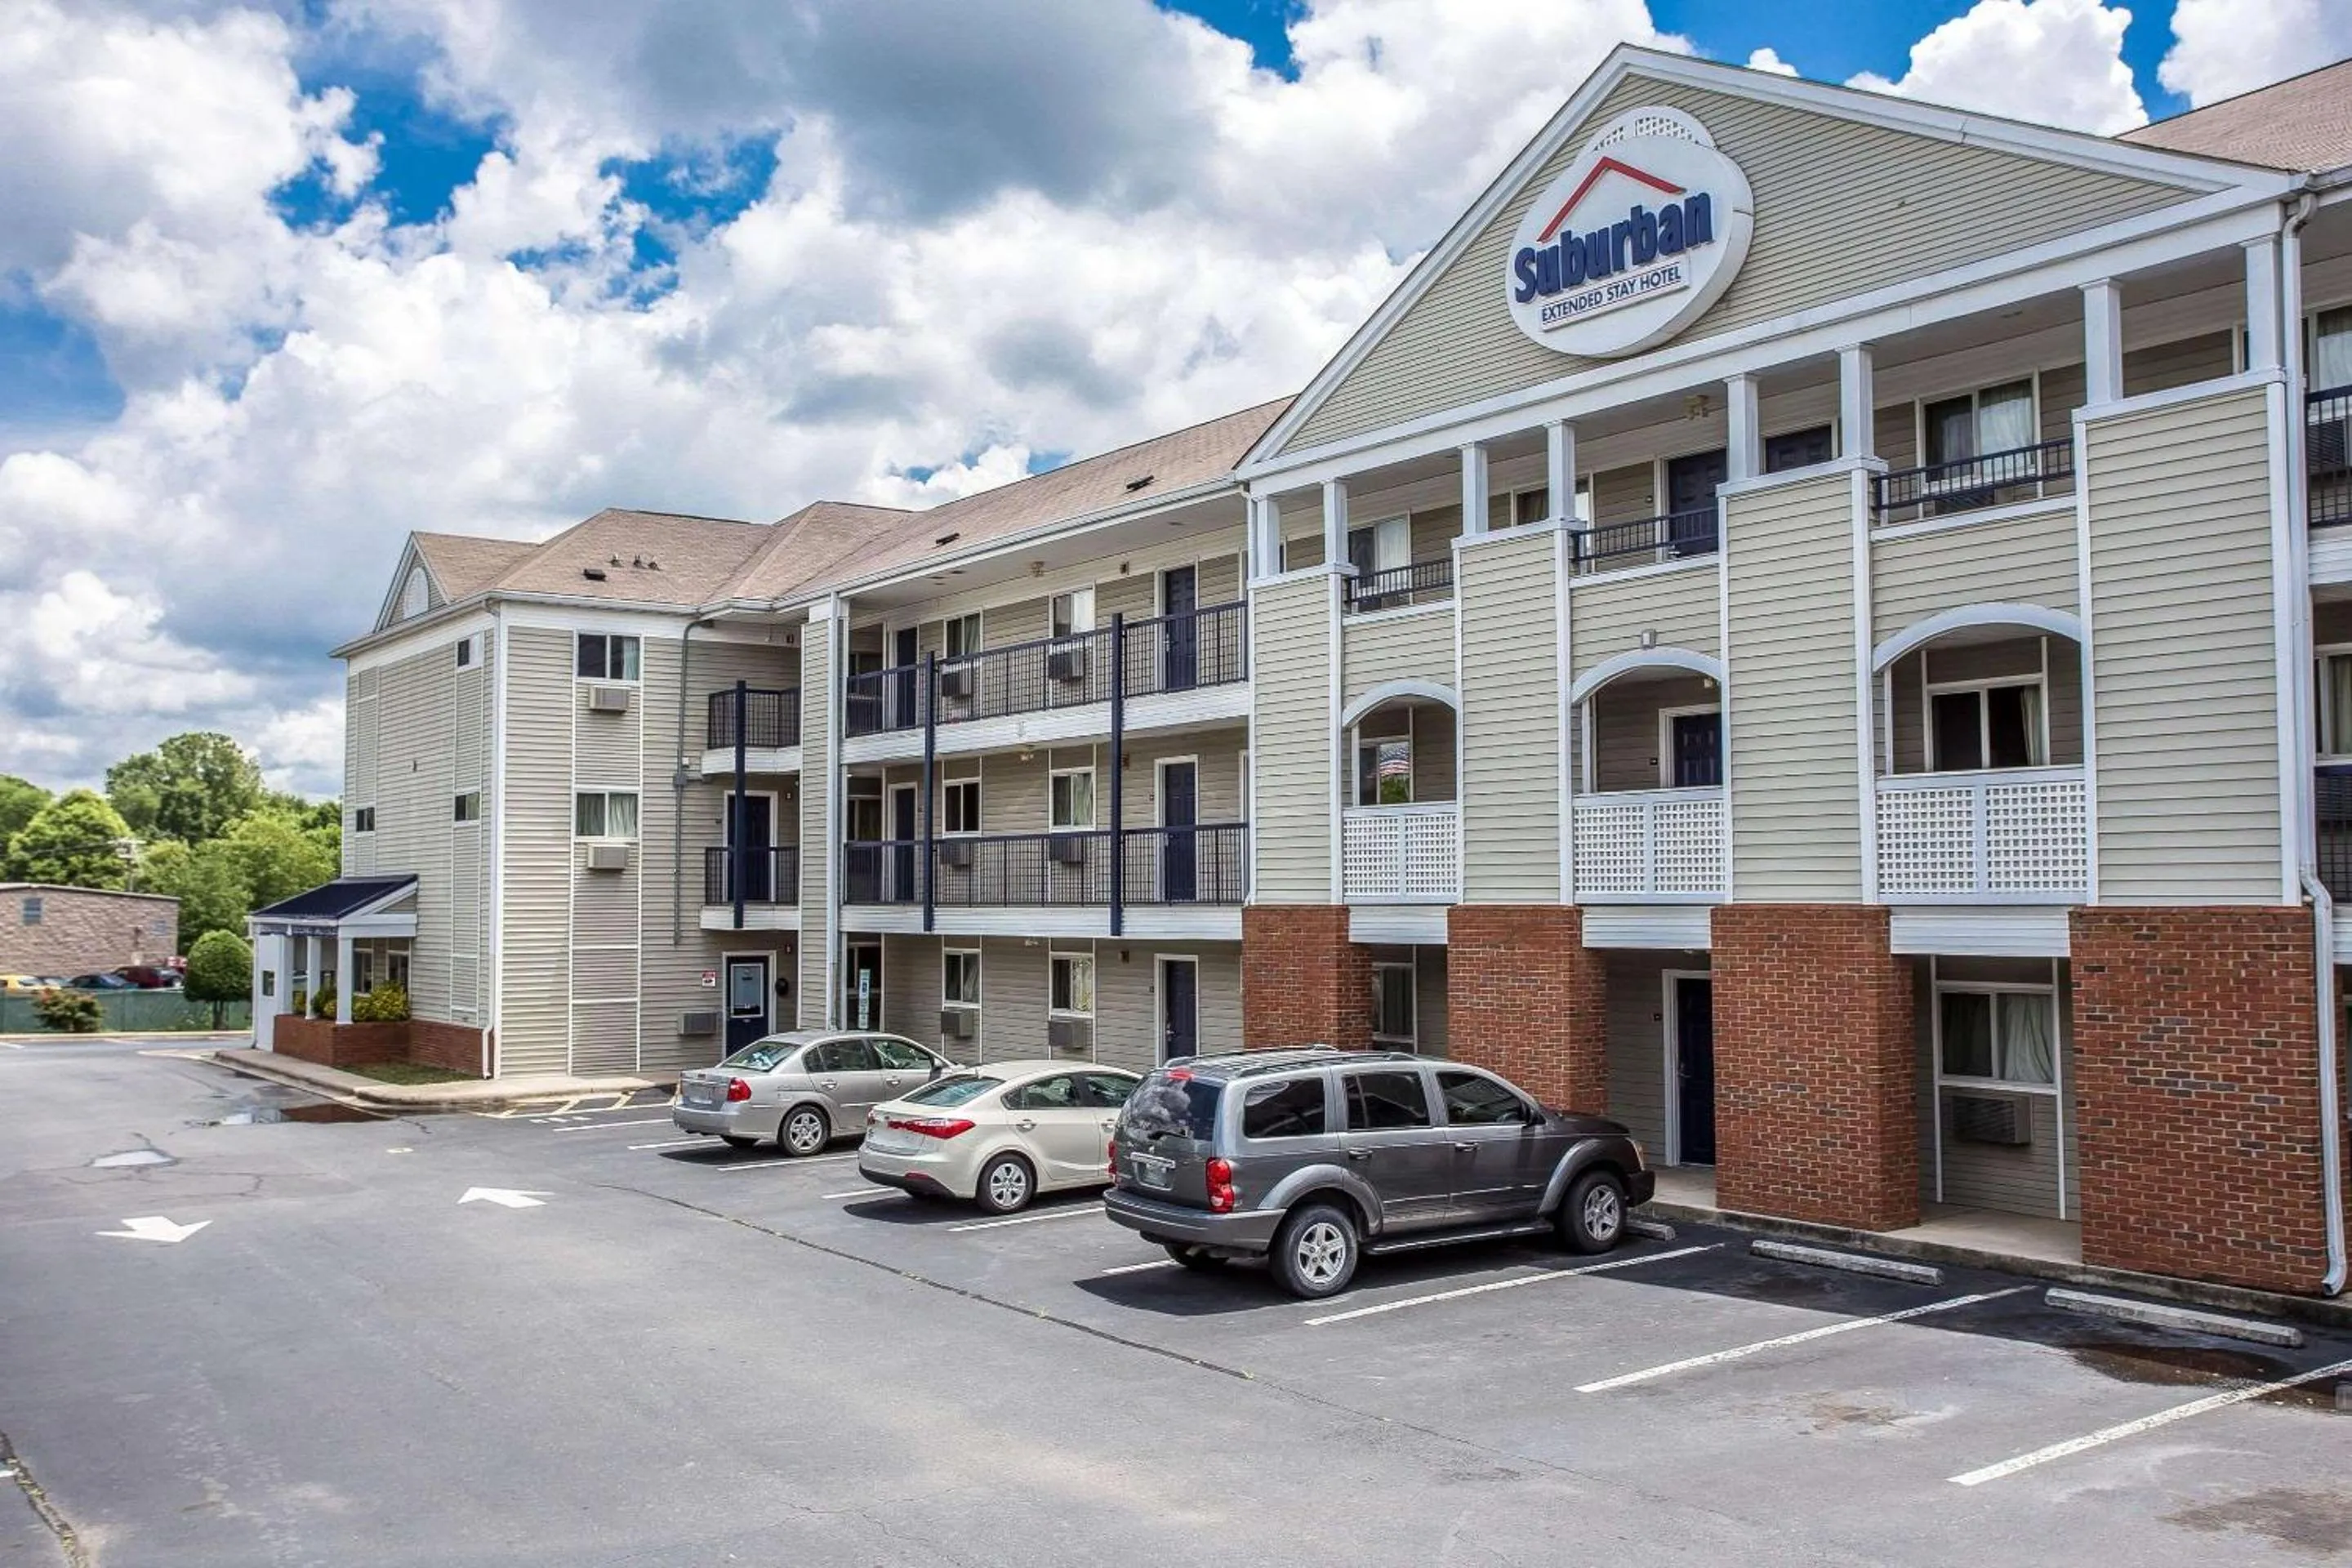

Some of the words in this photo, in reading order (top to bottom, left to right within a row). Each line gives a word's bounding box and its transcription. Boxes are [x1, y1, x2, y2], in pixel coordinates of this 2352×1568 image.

[1514, 192, 1713, 303] Suburban
[1542, 292, 1603, 322] EXTENDED
[1607, 278, 1637, 301] STAY
[1640, 266, 1682, 291] HOTEL
